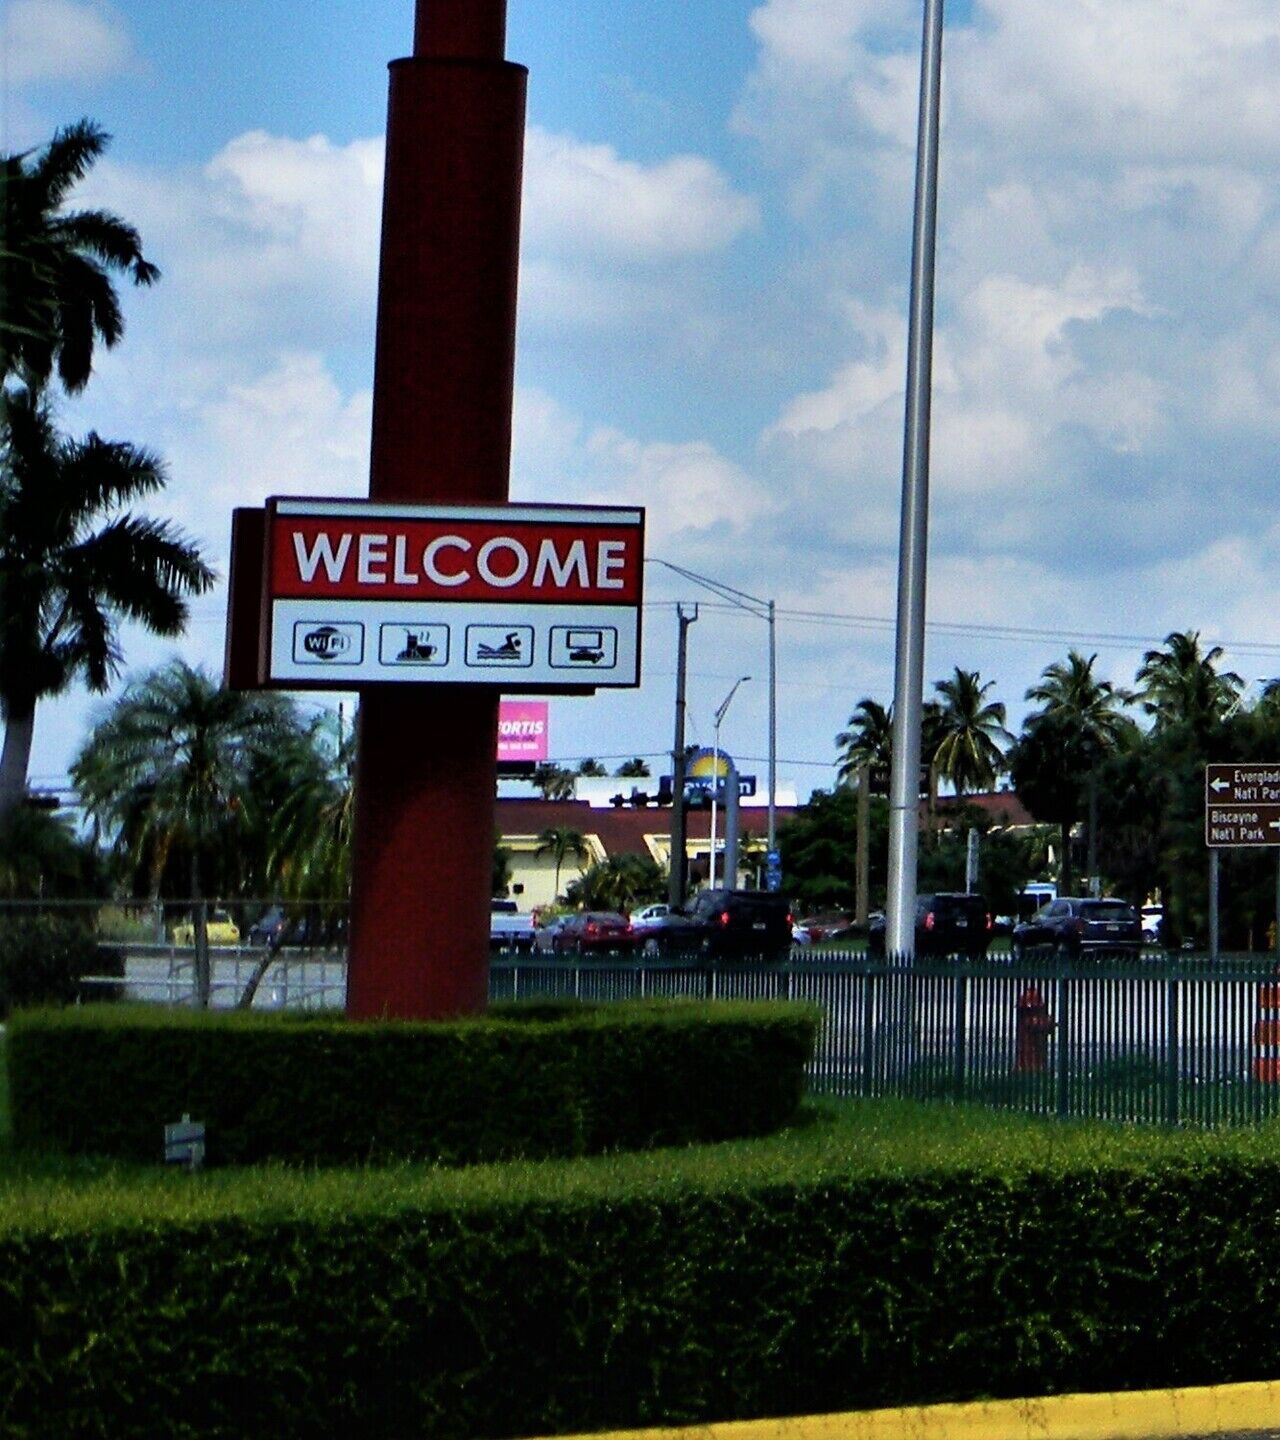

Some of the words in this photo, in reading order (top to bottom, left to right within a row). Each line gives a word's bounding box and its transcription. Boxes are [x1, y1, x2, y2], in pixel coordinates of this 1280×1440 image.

[293, 532, 626, 589] WELCOME
[1234, 787, 1258, 800] Nat'l
[1211, 810, 1258, 825] Biscayne
[1211, 827, 1235, 840] Nat'l
[1240, 827, 1265, 840] Park
